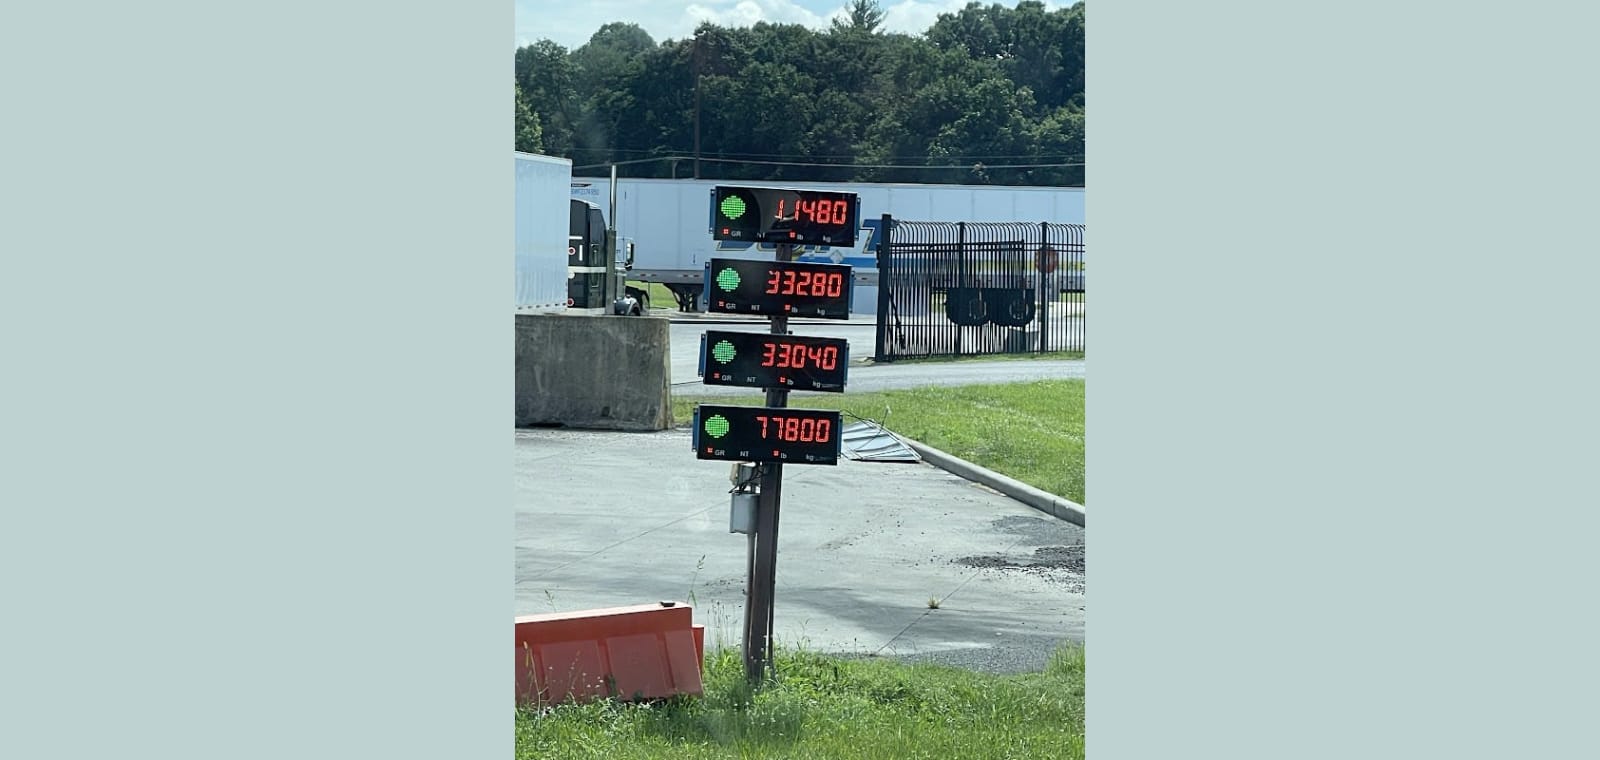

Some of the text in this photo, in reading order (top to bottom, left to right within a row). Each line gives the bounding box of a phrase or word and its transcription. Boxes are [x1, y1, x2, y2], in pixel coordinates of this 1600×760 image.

[777, 199, 848, 225] 11480
[766, 270, 842, 298] 33280
[725, 302, 737, 310] GR
[816, 307, 826, 316] kg
[762, 343, 838, 370] 33040
[756, 416, 831, 443] 77800
[714, 449, 726, 457] GR
[805, 453, 815, 461] kg
